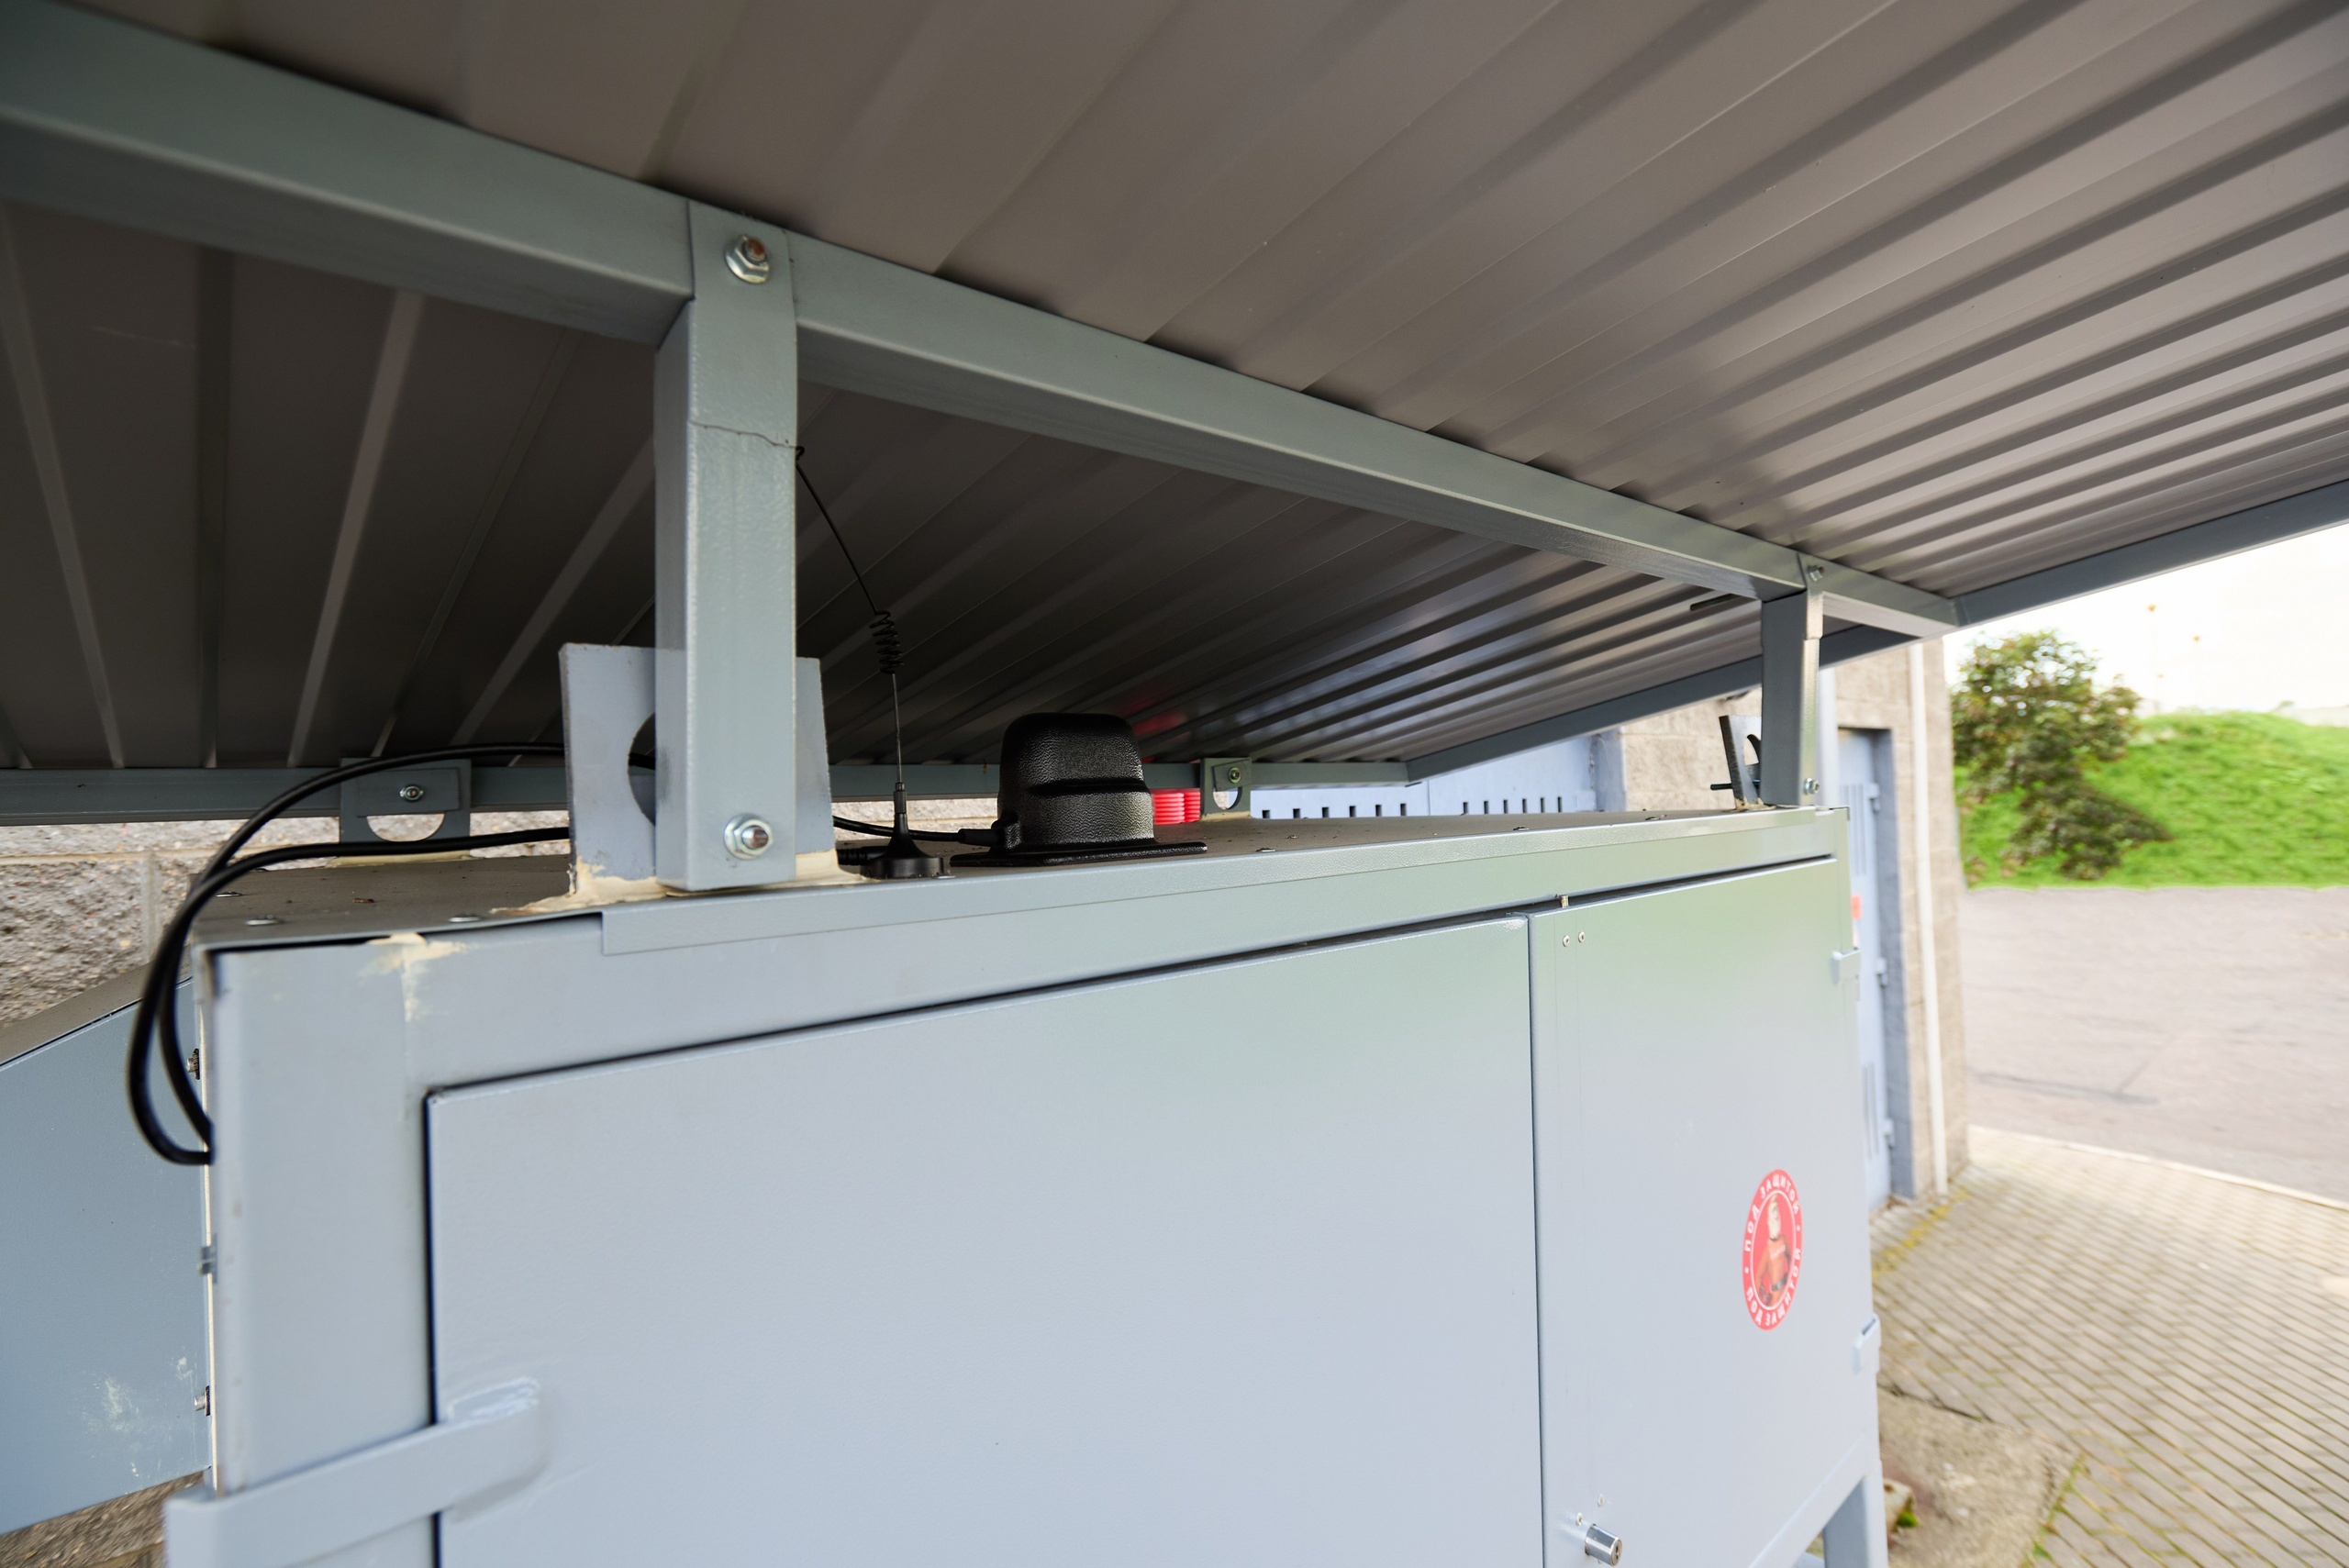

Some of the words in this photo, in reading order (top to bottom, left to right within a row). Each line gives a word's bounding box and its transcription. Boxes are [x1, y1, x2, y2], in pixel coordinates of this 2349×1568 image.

[1744, 1204, 1760, 1251] ПОД
[1760, 1173, 1800, 1215] ЗАЩИТОЙ
[1746, 1286, 1763, 1326] ПОД
[1765, 1249, 1801, 1327] ЗАЩИТОЙ
